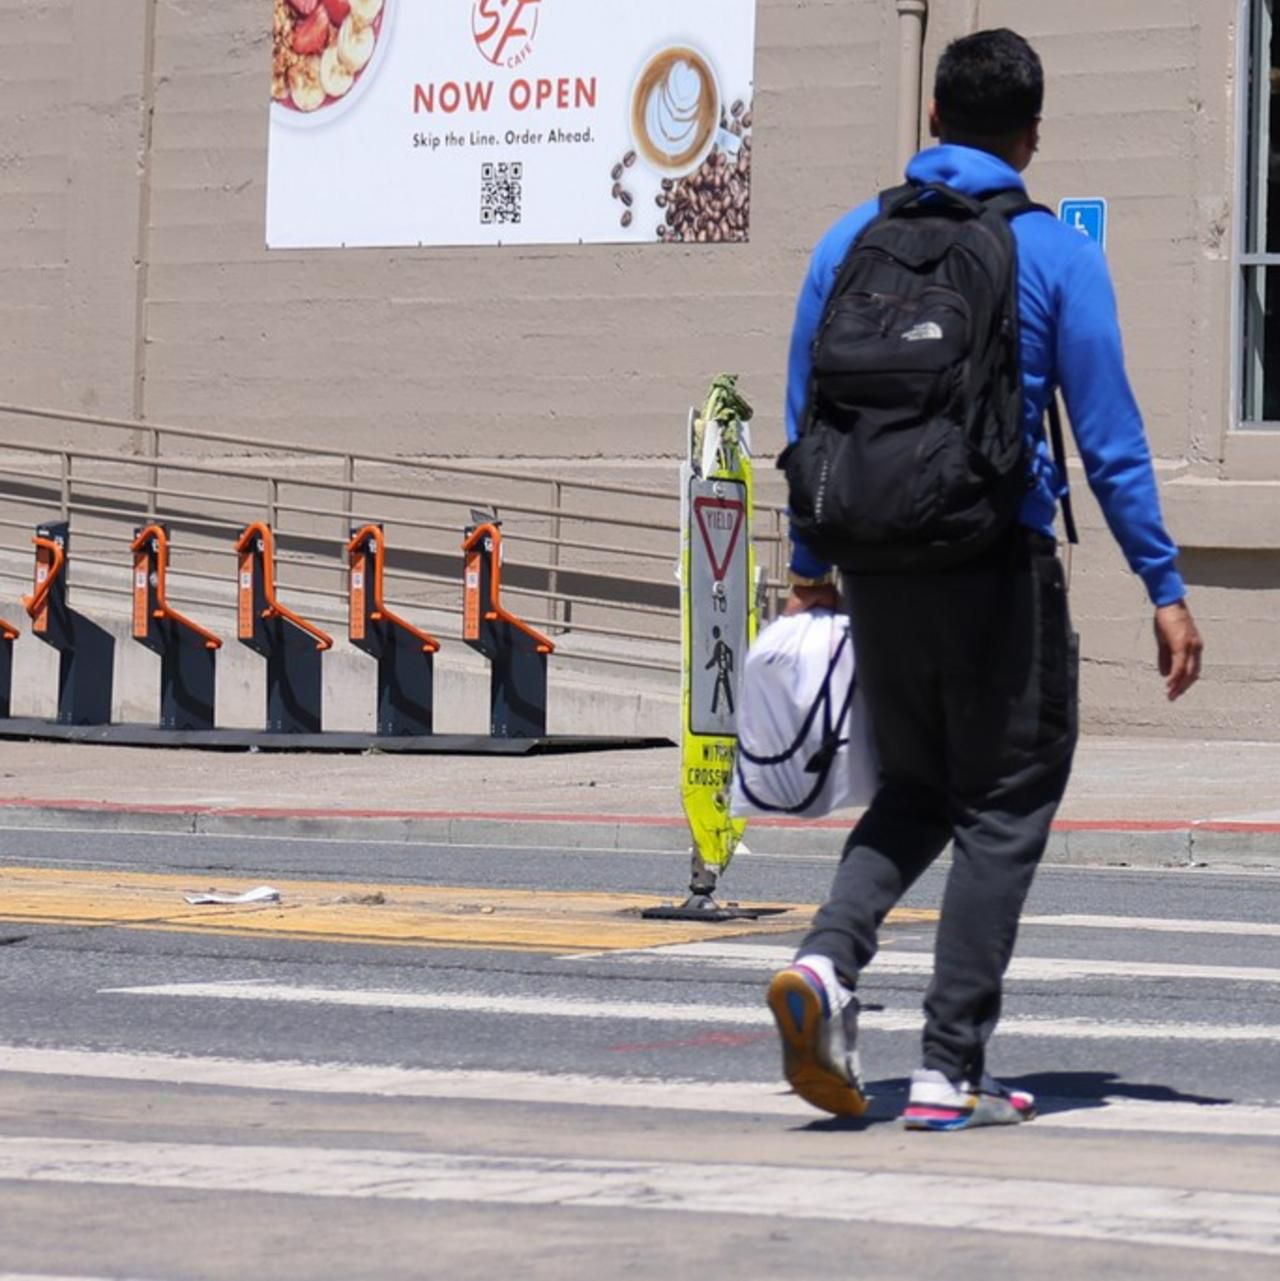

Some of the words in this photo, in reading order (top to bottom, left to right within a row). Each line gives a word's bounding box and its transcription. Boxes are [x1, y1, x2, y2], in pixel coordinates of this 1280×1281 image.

[413, 81, 494, 114] NOW
[509, 77, 597, 111] OPEN
[413, 132, 441, 151] Skip
[445, 132, 465, 147] the
[470, 130, 500, 146] Line.
[504, 129, 543, 145] Order
[548, 127, 595, 144] Ahead.
[705, 510, 734, 530] YIELD
